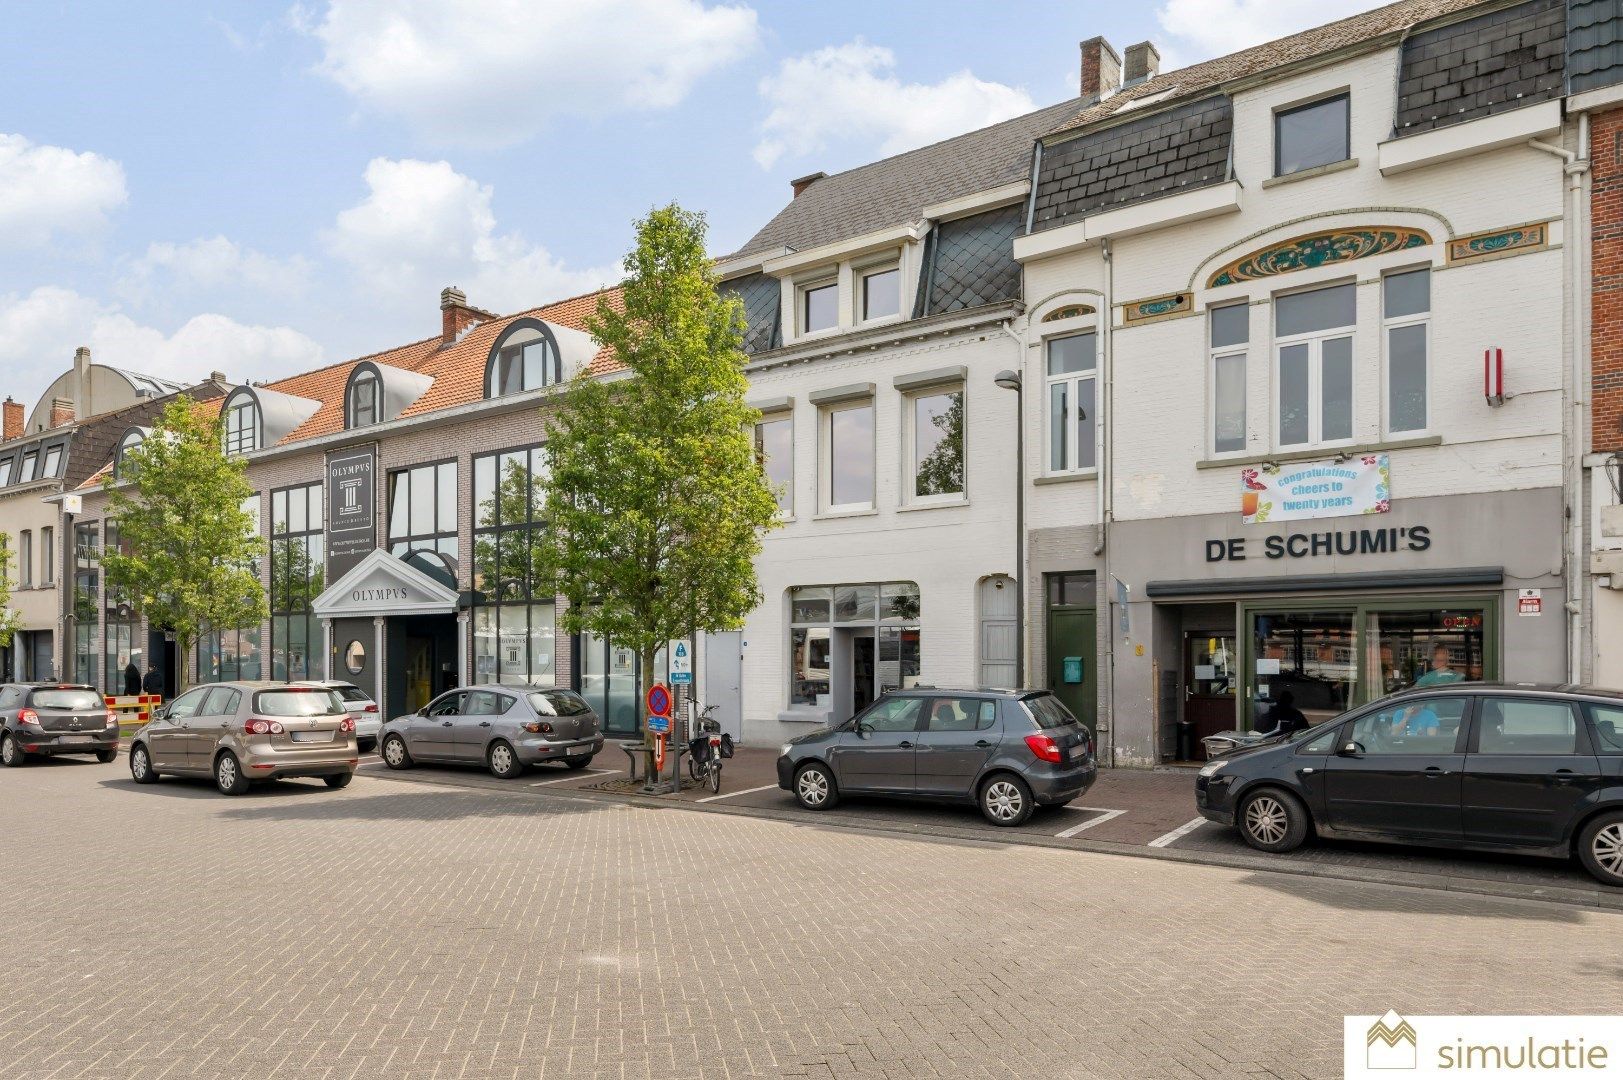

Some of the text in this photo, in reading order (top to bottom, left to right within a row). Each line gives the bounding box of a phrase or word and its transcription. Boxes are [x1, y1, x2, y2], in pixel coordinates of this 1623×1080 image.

[1277, 467, 1358, 488] congratulations
[1291, 482, 1343, 496] cheers to
[1283, 496, 1352, 511] twenty years
[1205, 525, 1431, 562] DE SCHUMI'S
[352, 587, 407, 602] OLYMPVS
